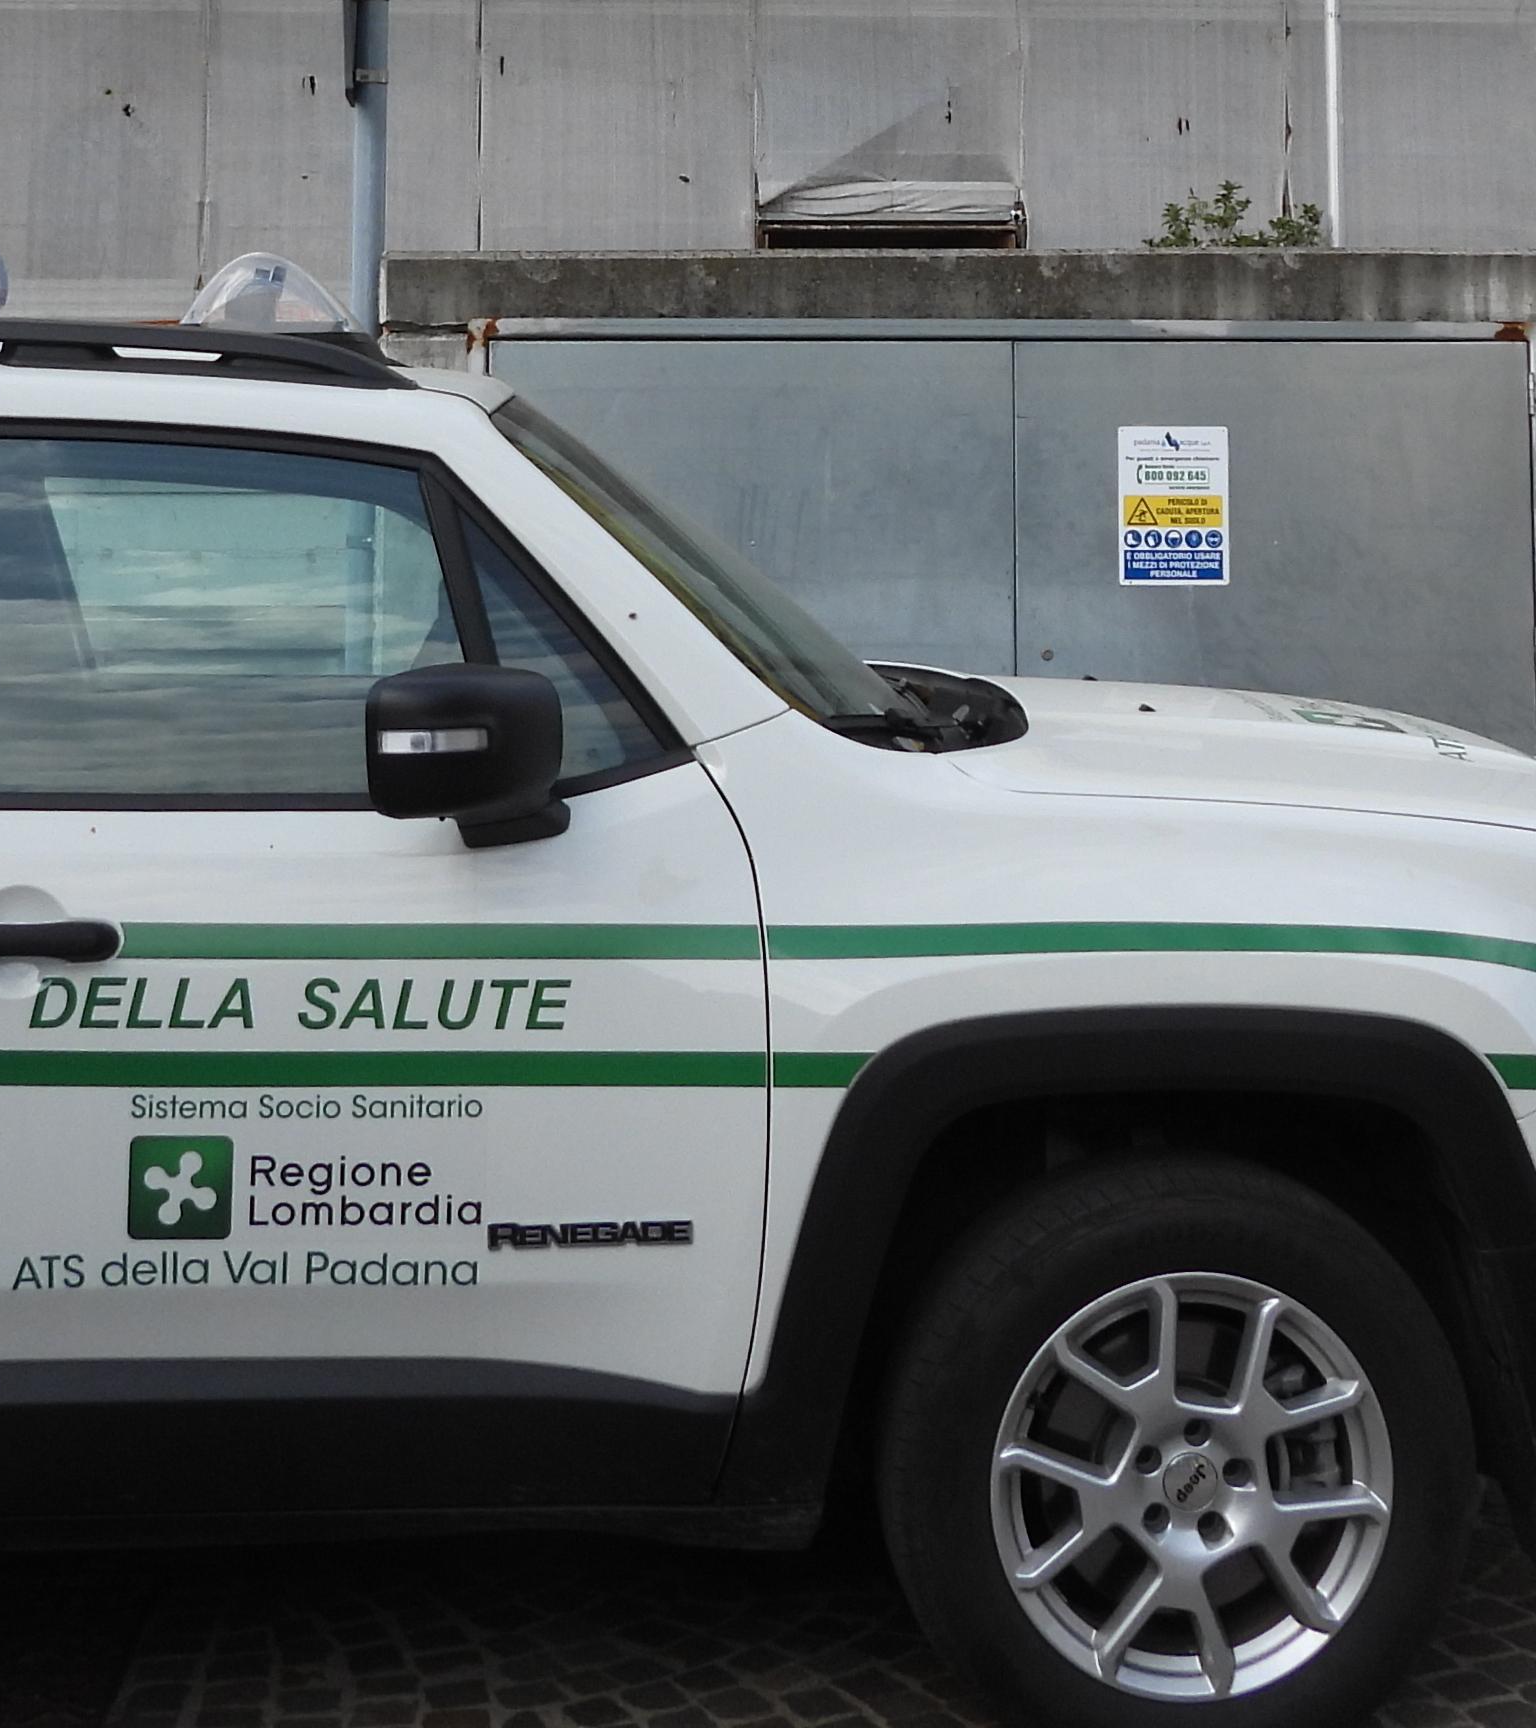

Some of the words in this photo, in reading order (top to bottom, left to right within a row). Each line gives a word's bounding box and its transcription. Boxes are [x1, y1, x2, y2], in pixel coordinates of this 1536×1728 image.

[27, 976, 256, 1030] DELLA
[297, 976, 573, 1031] SALUTE
[130, 1094, 248, 1120] Sistema
[258, 1094, 342, 1120] Socio
[351, 1094, 483, 1120] Sanitario
[249, 1155, 433, 1194] Regione
[248, 1195, 483, 1227] Lombardia
[487, 1220, 694, 1251] RENEGADE
[12, 1255, 86, 1291] ATS
[100, 1252, 210, 1287] della
[223, 1250, 289, 1286] Val
[305, 1251, 480, 1287] Padana
[1176, 1463, 1206, 1503] Jeep
